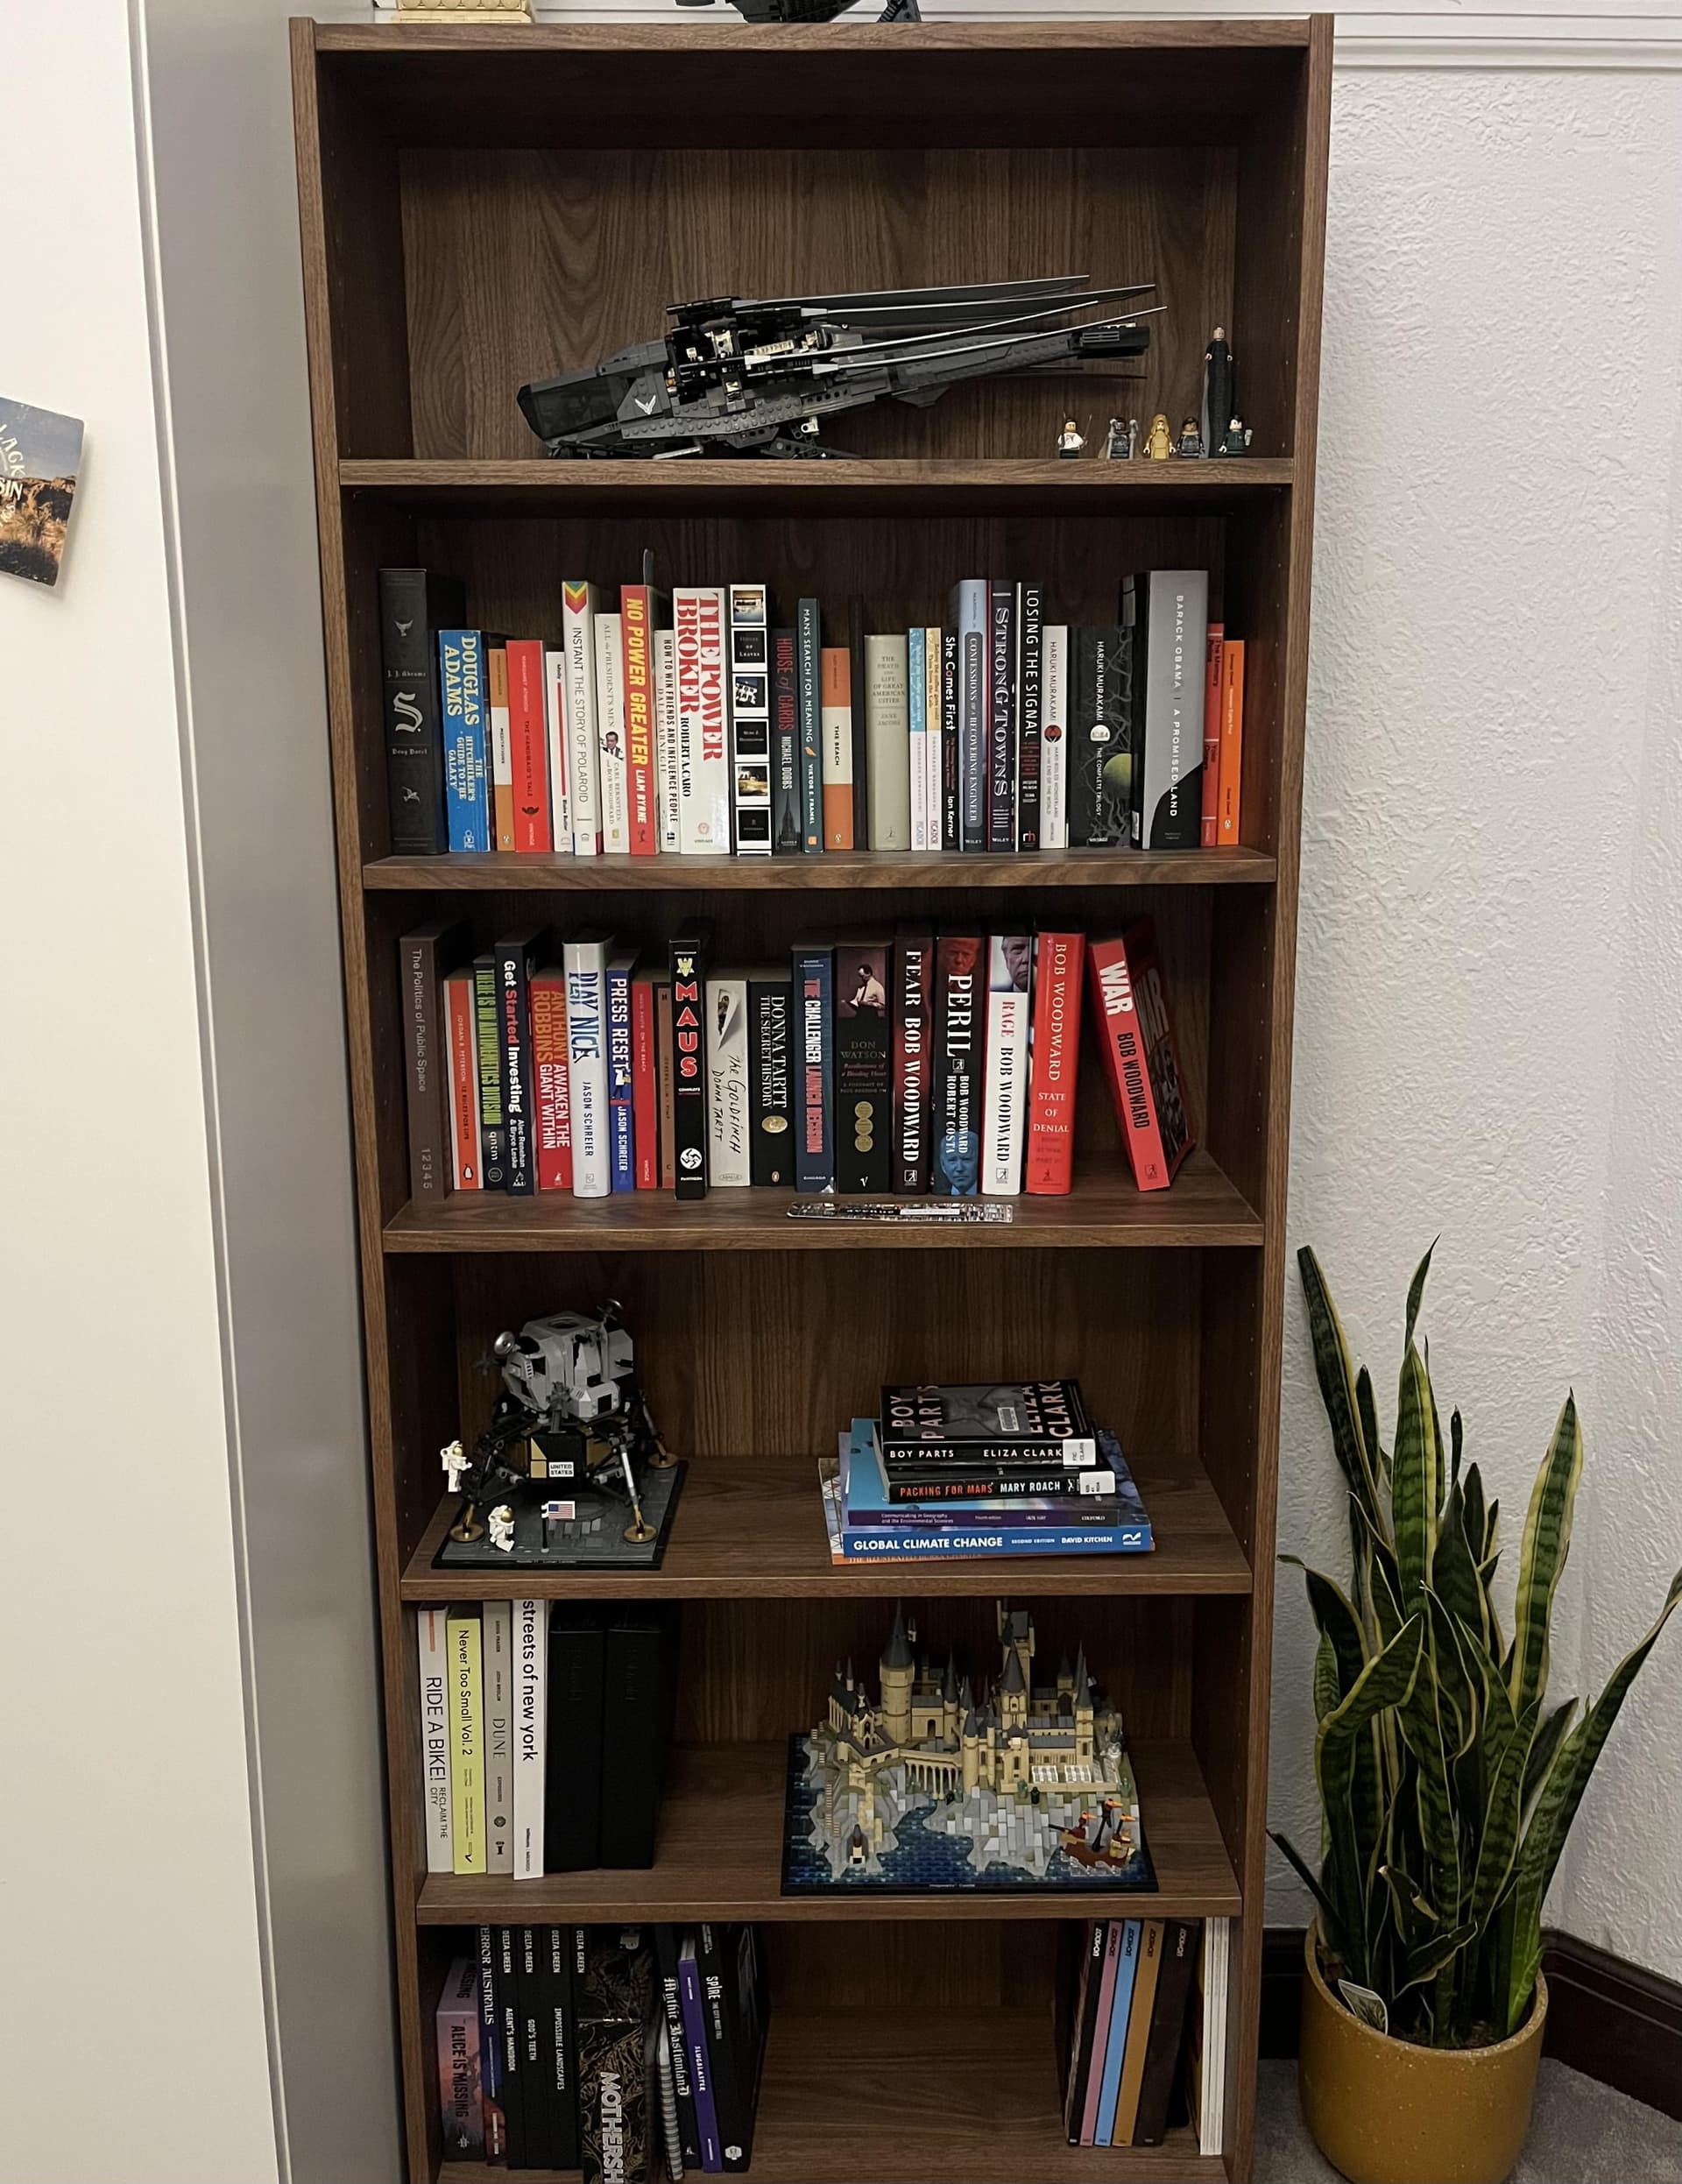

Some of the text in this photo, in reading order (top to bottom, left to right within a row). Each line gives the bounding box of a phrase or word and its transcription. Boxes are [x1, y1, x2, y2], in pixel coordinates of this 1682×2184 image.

[1026, 590, 1039, 645] LOSING
[677, 597, 701, 715] BROKER
[945, 636, 956, 657] She
[1027, 648, 1038, 677] THE
[1174, 647, 1183, 689] OBAMA
[444, 645, 463, 717] ADAMS
[460, 636, 480, 725] DOUGLAS
[699, 592, 723, 761] THE POWER
[775, 638, 795, 731] HOUSE CARDS
[945, 660, 955, 703] Comes
[994, 607, 1010, 796] STRONG TOWNS
[572, 627, 589, 802] INSTANT THE STORY OF POLAROID
[626, 597, 648, 823] NO POWER GREATER LIAM BYRNE
[663, 639, 679, 823] HOW TO WIN FRIENDS AND INFLUENCE PEOPLE
[681, 717, 690, 758] ROBERT
[945, 705, 956, 731] First
[1025, 682, 1037, 737] SIGNAL
[458, 768, 464, 781] TO
[465, 735, 476, 802] HITCHHIKER'S
[781, 737, 792, 766] MICHAEL
[1171, 721, 1180, 781] PROMISED
[412, 949, 426, 1057] The Politics Public
[611, 979, 627, 1023] PRESS
[947, 974, 973, 1057] PERIL
[1049, 944, 1067, 1081] BOB WOODWARD
[1099, 960, 1133, 1016] WAR
[504, 960, 522, 1113] Get Started Investing
[569, 972, 599, 1064] PLAY NICE
[675, 981, 699, 1077] MAUS
[804, 1000, 822, 1064] CHALLENGER
[534, 991, 556, 1149] ROBBINS GIANT WITHIN
[551, 991, 569, 1147] ANTHONY AWAKEN THE
[760, 995, 772, 1108] THE SECRET HISTORY
[772, 997, 787, 1107] DONNA TARTT
[840, 1050, 887, 1059] WATSON
[903, 951, 922, 1162] FEAR BOB WOODWARD
[1117, 1032, 1150, 1128] BOB WOODWARD
[712, 1070, 724, 1141] DONNA TARTT
[946, 1075, 957, 1118] ROBERT
[996, 1001, 1015, 1162] RAGE BOB WOODWARD
[1038, 1092, 1066, 1101] STATE
[583, 1082, 593, 1156] JASON SCHREIER
[618, 1106, 627, 1171] JASON SCHREIER
[958, 1075, 970, 1154] BOB WOODWARD
[1033, 1124, 1070, 1133] DENIAL
[1045, 1108, 1057, 1117] OF
[488, 1132, 498, 1161] qntm
[890, 1395, 915, 1428] BOY
[918, 1384, 945, 1439] PARTS
[1021, 1385, 1043, 1435] ELIZA
[1039, 1381, 1074, 1438] CLARK
[889, 1448, 1063, 1458] BOY PARTS ELIZA CLARK
[900, 1485, 964, 1498] PACKING FOR
[1000, 1481, 1061, 1493] MARY ROACH
[853, 1537, 1003, 1551] GLOBAL CLIMATE CHANGE
[458, 1629, 469, 1665] Never
[459, 1668, 470, 1688] Too
[460, 1691, 471, 1721] Small
[520, 1601, 538, 1761] streets of new york
[427, 1677, 445, 1780] RIDE A BIKE!
[461, 1724, 471, 1746] Vol.
[492, 1718, 505, 1759] DUNE
[483, 1967, 495, 2025] AUSTRALIS
[664, 1977, 679, 2018] Mythic
[706, 1975, 721, 2000] SPIRE
[450, 2025, 469, 2117] ALICE IS MISSING
[695, 2046, 706, 2092] SLUGBLASTER
